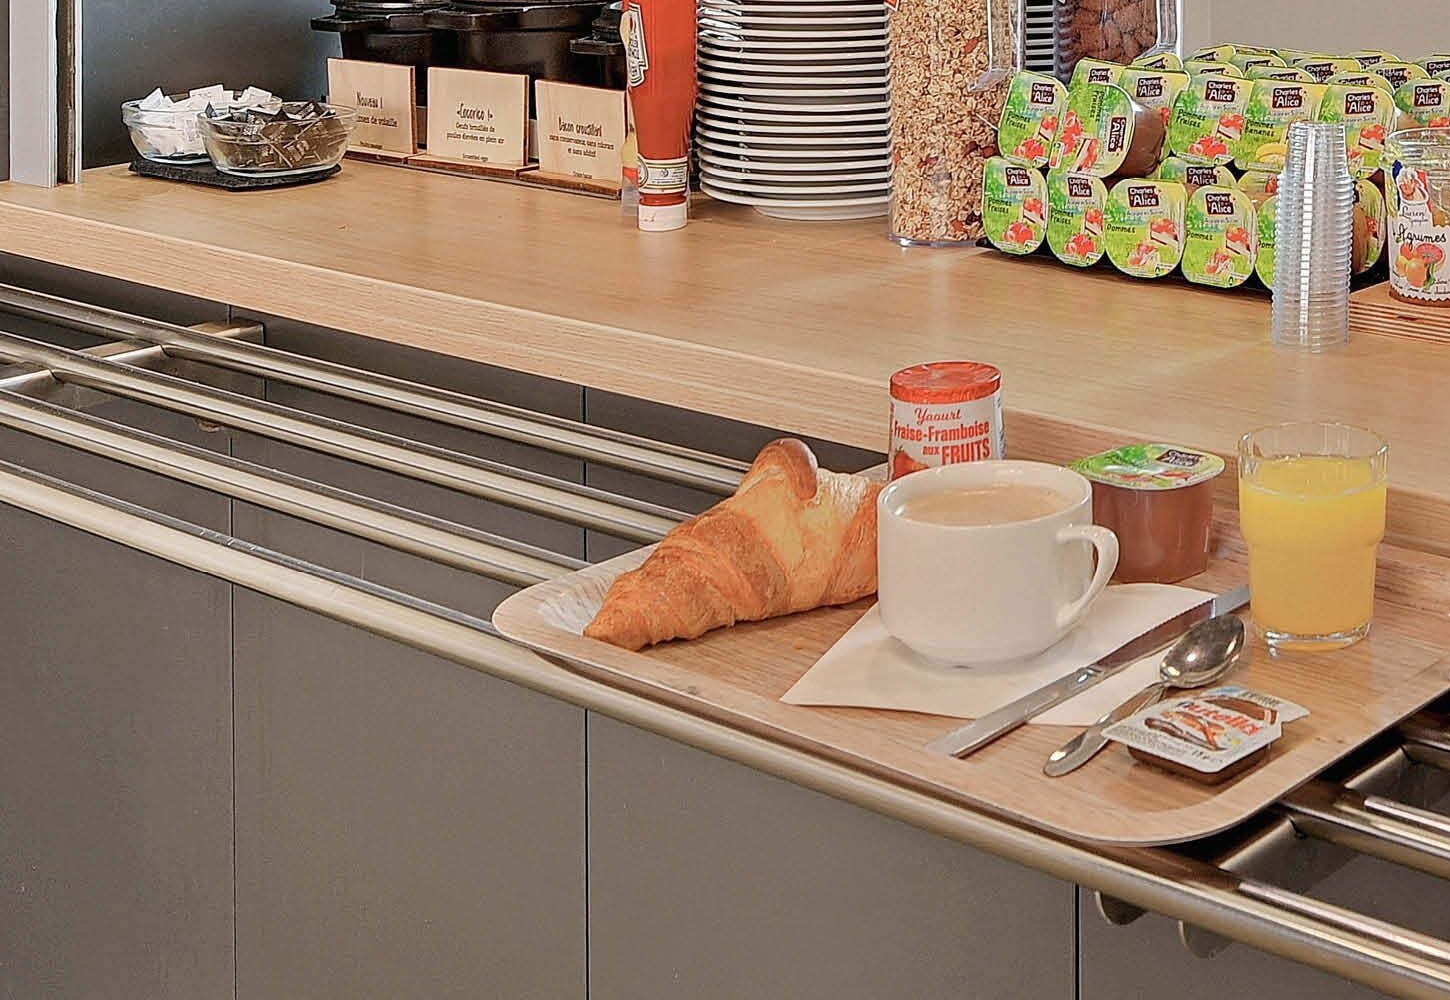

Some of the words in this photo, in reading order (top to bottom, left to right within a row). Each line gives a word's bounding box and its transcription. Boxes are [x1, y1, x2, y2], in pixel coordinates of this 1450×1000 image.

[1140, 85, 1162, 96] Alice
[1207, 82, 1233, 90] Charles
[1208, 90, 1233, 101] Alice
[1275, 88, 1299, 96] Charles
[1347, 93, 1371, 101] Charles
[1034, 92, 1053, 104] Alice
[1276, 96, 1300, 107] Alice
[1418, 94, 1439, 105] Alice
[1348, 101, 1372, 113] Alice
[1009, 175, 1029, 185] Alice
[1072, 185, 1090, 196] Alice
[1130, 187, 1153, 195] Charles
[1132, 194, 1157, 206] Alice
[1207, 194, 1230, 202] Charles
[1209, 201, 1232, 214] Alice
[1395, 223, 1447, 251] Agrumes
[915, 407, 962, 425] Yaourt
[922, 446, 940, 455] aux
[941, 438, 990, 465] FRUITS
